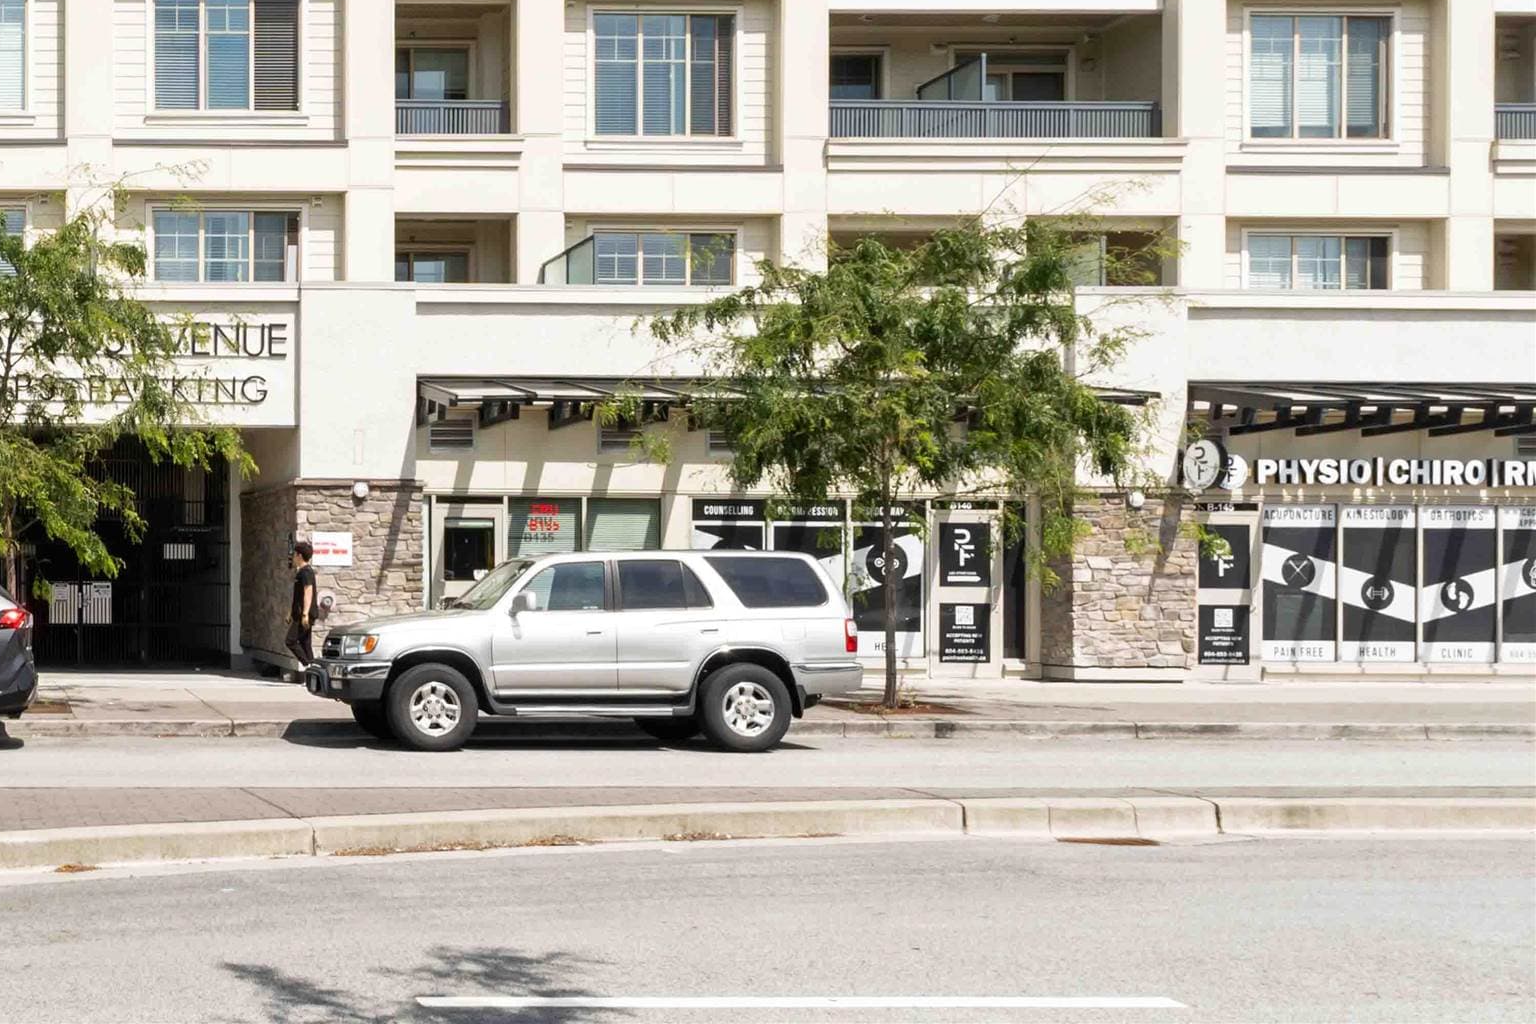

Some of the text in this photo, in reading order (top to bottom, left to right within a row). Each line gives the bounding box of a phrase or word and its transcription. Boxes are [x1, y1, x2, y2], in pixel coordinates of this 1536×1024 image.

[132, 323, 287, 357] VENUE
[89, 375, 268, 403] PAKING
[1257, 459, 1372, 485] PHYSIO
[1388, 459, 1487, 486] CHIRO
[703, 505, 754, 516] COUNSELLING
[1346, 509, 1409, 521] KINESIOLOGY
[1430, 510, 1484, 521] ORTHOTICS
[1273, 646, 1324, 657] PAIN FREE
[1359, 646, 1396, 657] HEALTH
[1440, 648, 1473, 658] CLINIC
